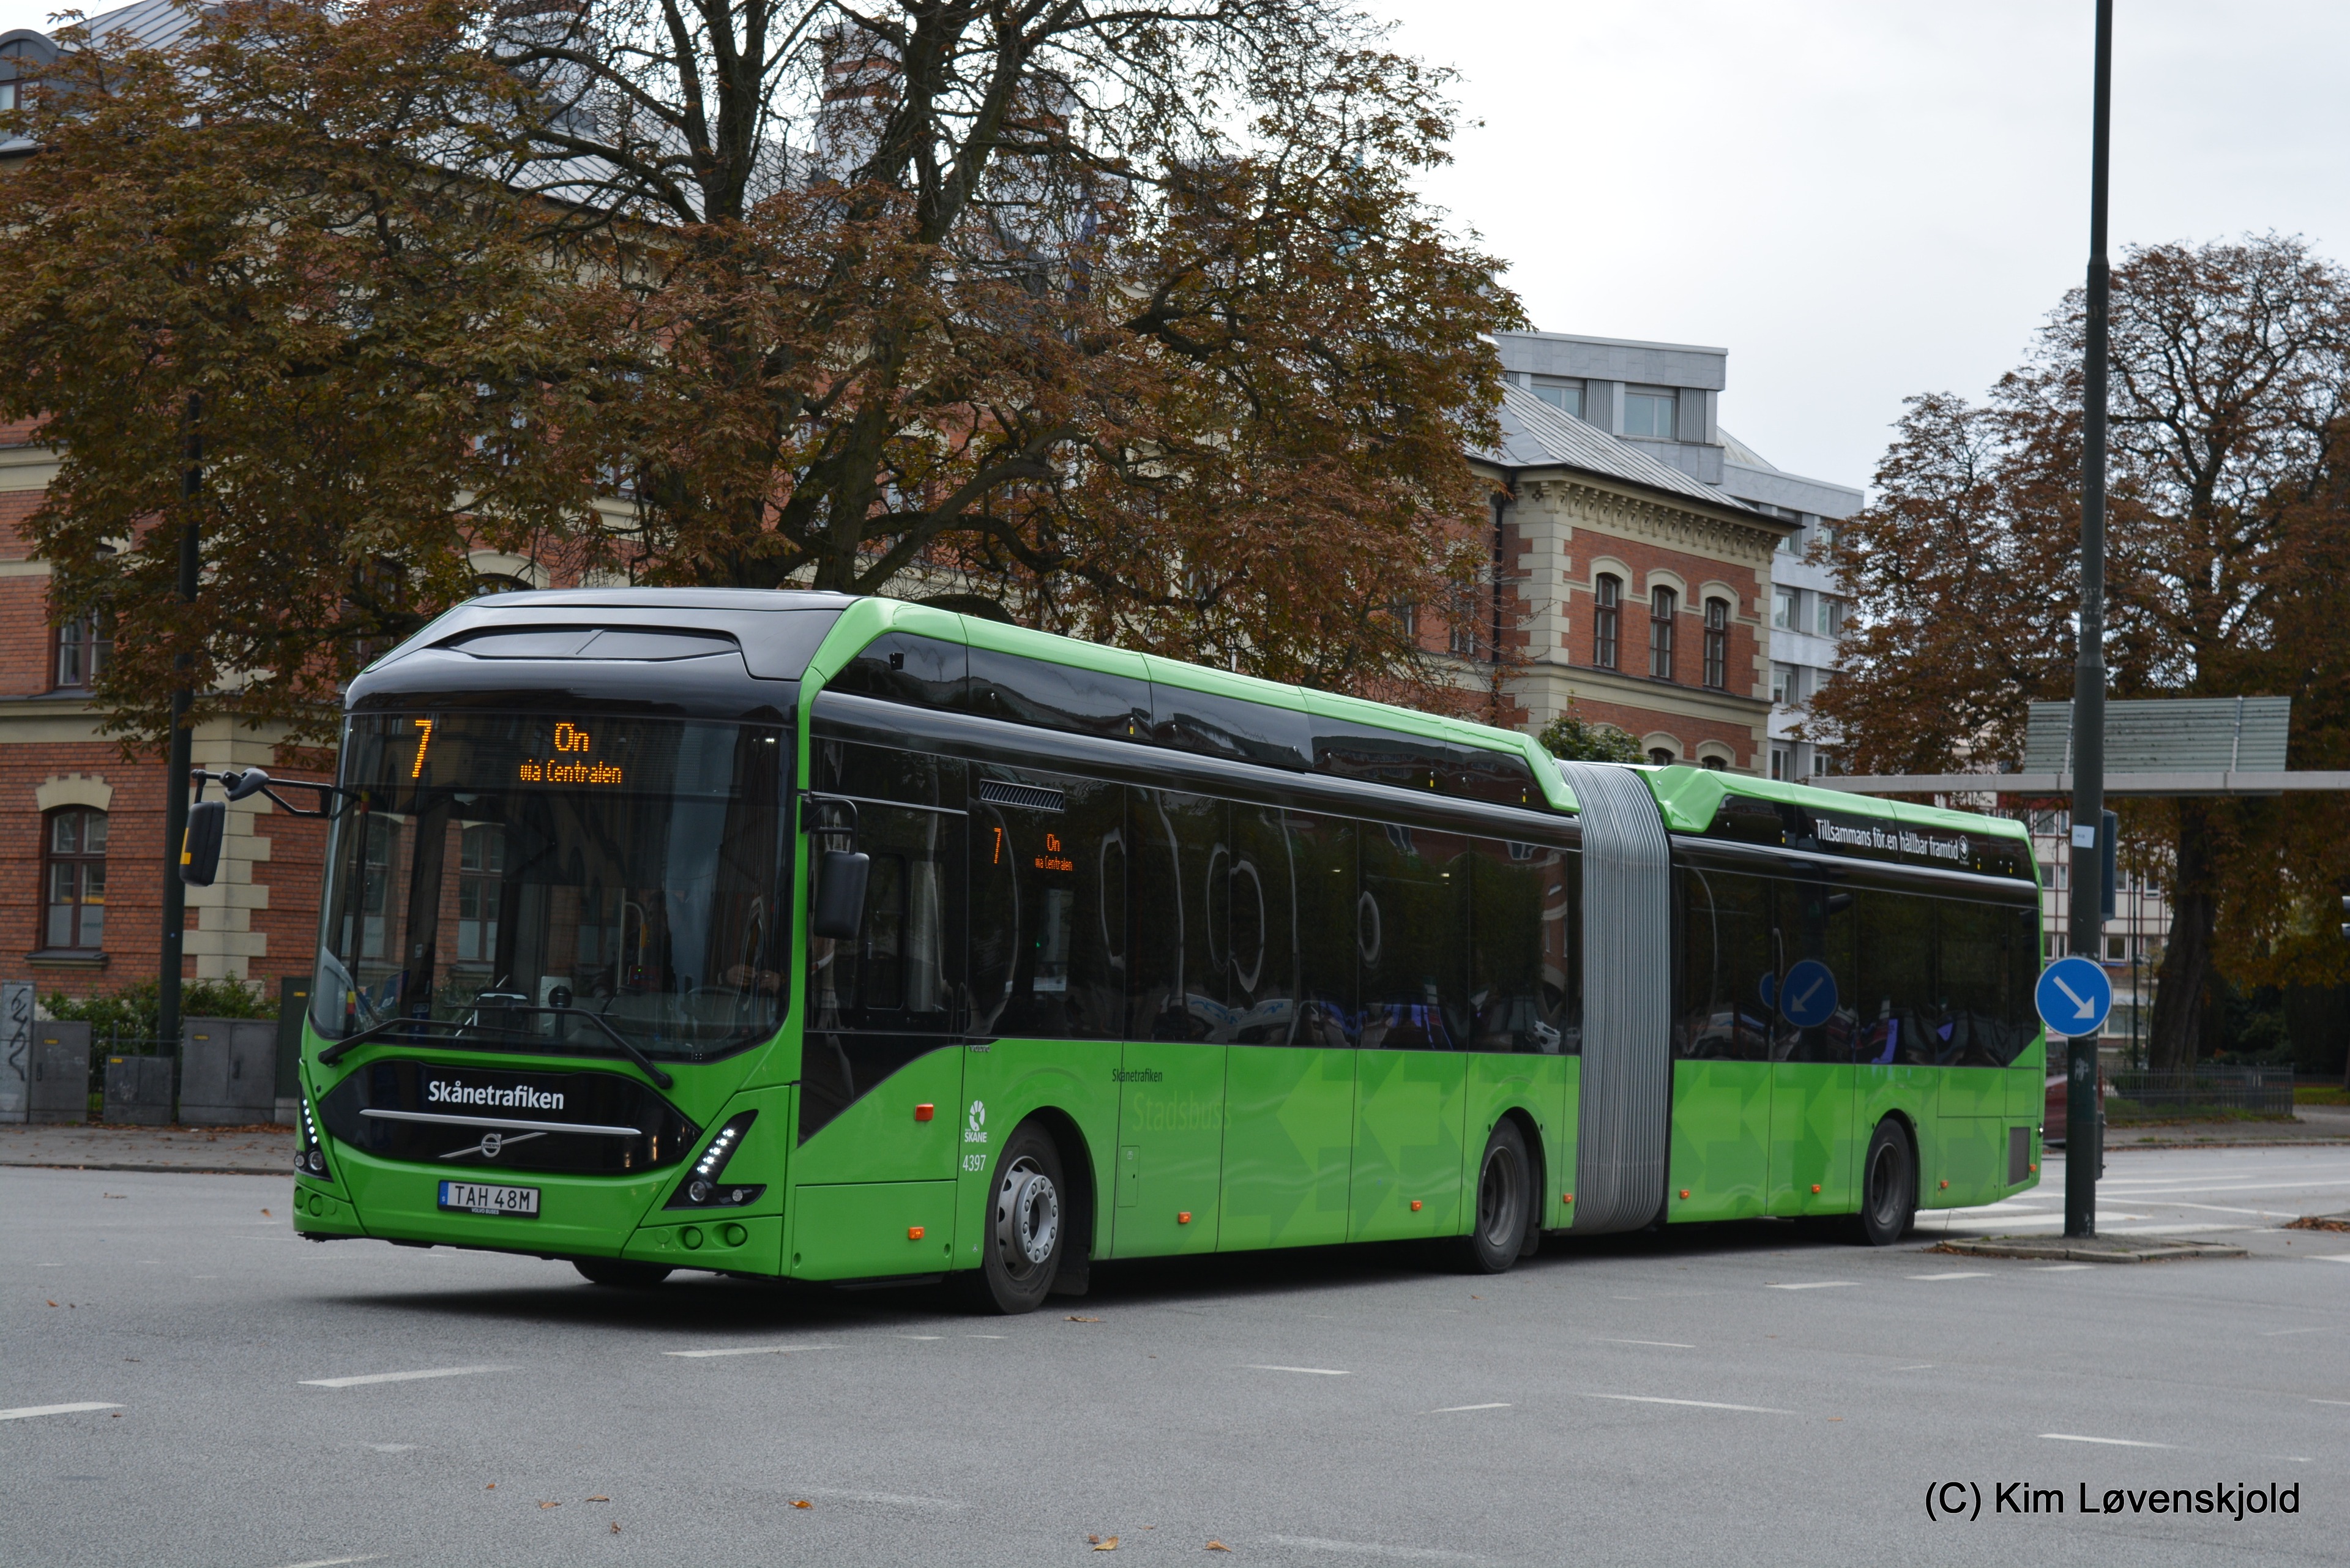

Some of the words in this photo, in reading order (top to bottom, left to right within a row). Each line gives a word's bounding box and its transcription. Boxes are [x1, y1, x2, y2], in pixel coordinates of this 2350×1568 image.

[412, 720, 431, 777] 7
[554, 723, 589, 752] Ön
[520, 759, 541, 781] via
[546, 760, 622, 783] Centralen
[1815, 819, 1872, 847] Tillsammans
[1872, 827, 1886, 849] för
[1898, 831, 1928, 856] hållbar
[1928, 835, 1958, 860] framtid
[969, 1045, 991, 1053] VOLVO
[1112, 1067, 1163, 1083] Skånetrafiken
[428, 1080, 564, 1110] Skånetrafiken
[1133, 1090, 1231, 1131] Stadsbuss
[963, 1154, 987, 1171] 4397
[455, 1185, 489, 1207] TAH
[494, 1189, 531, 1211] 48M
